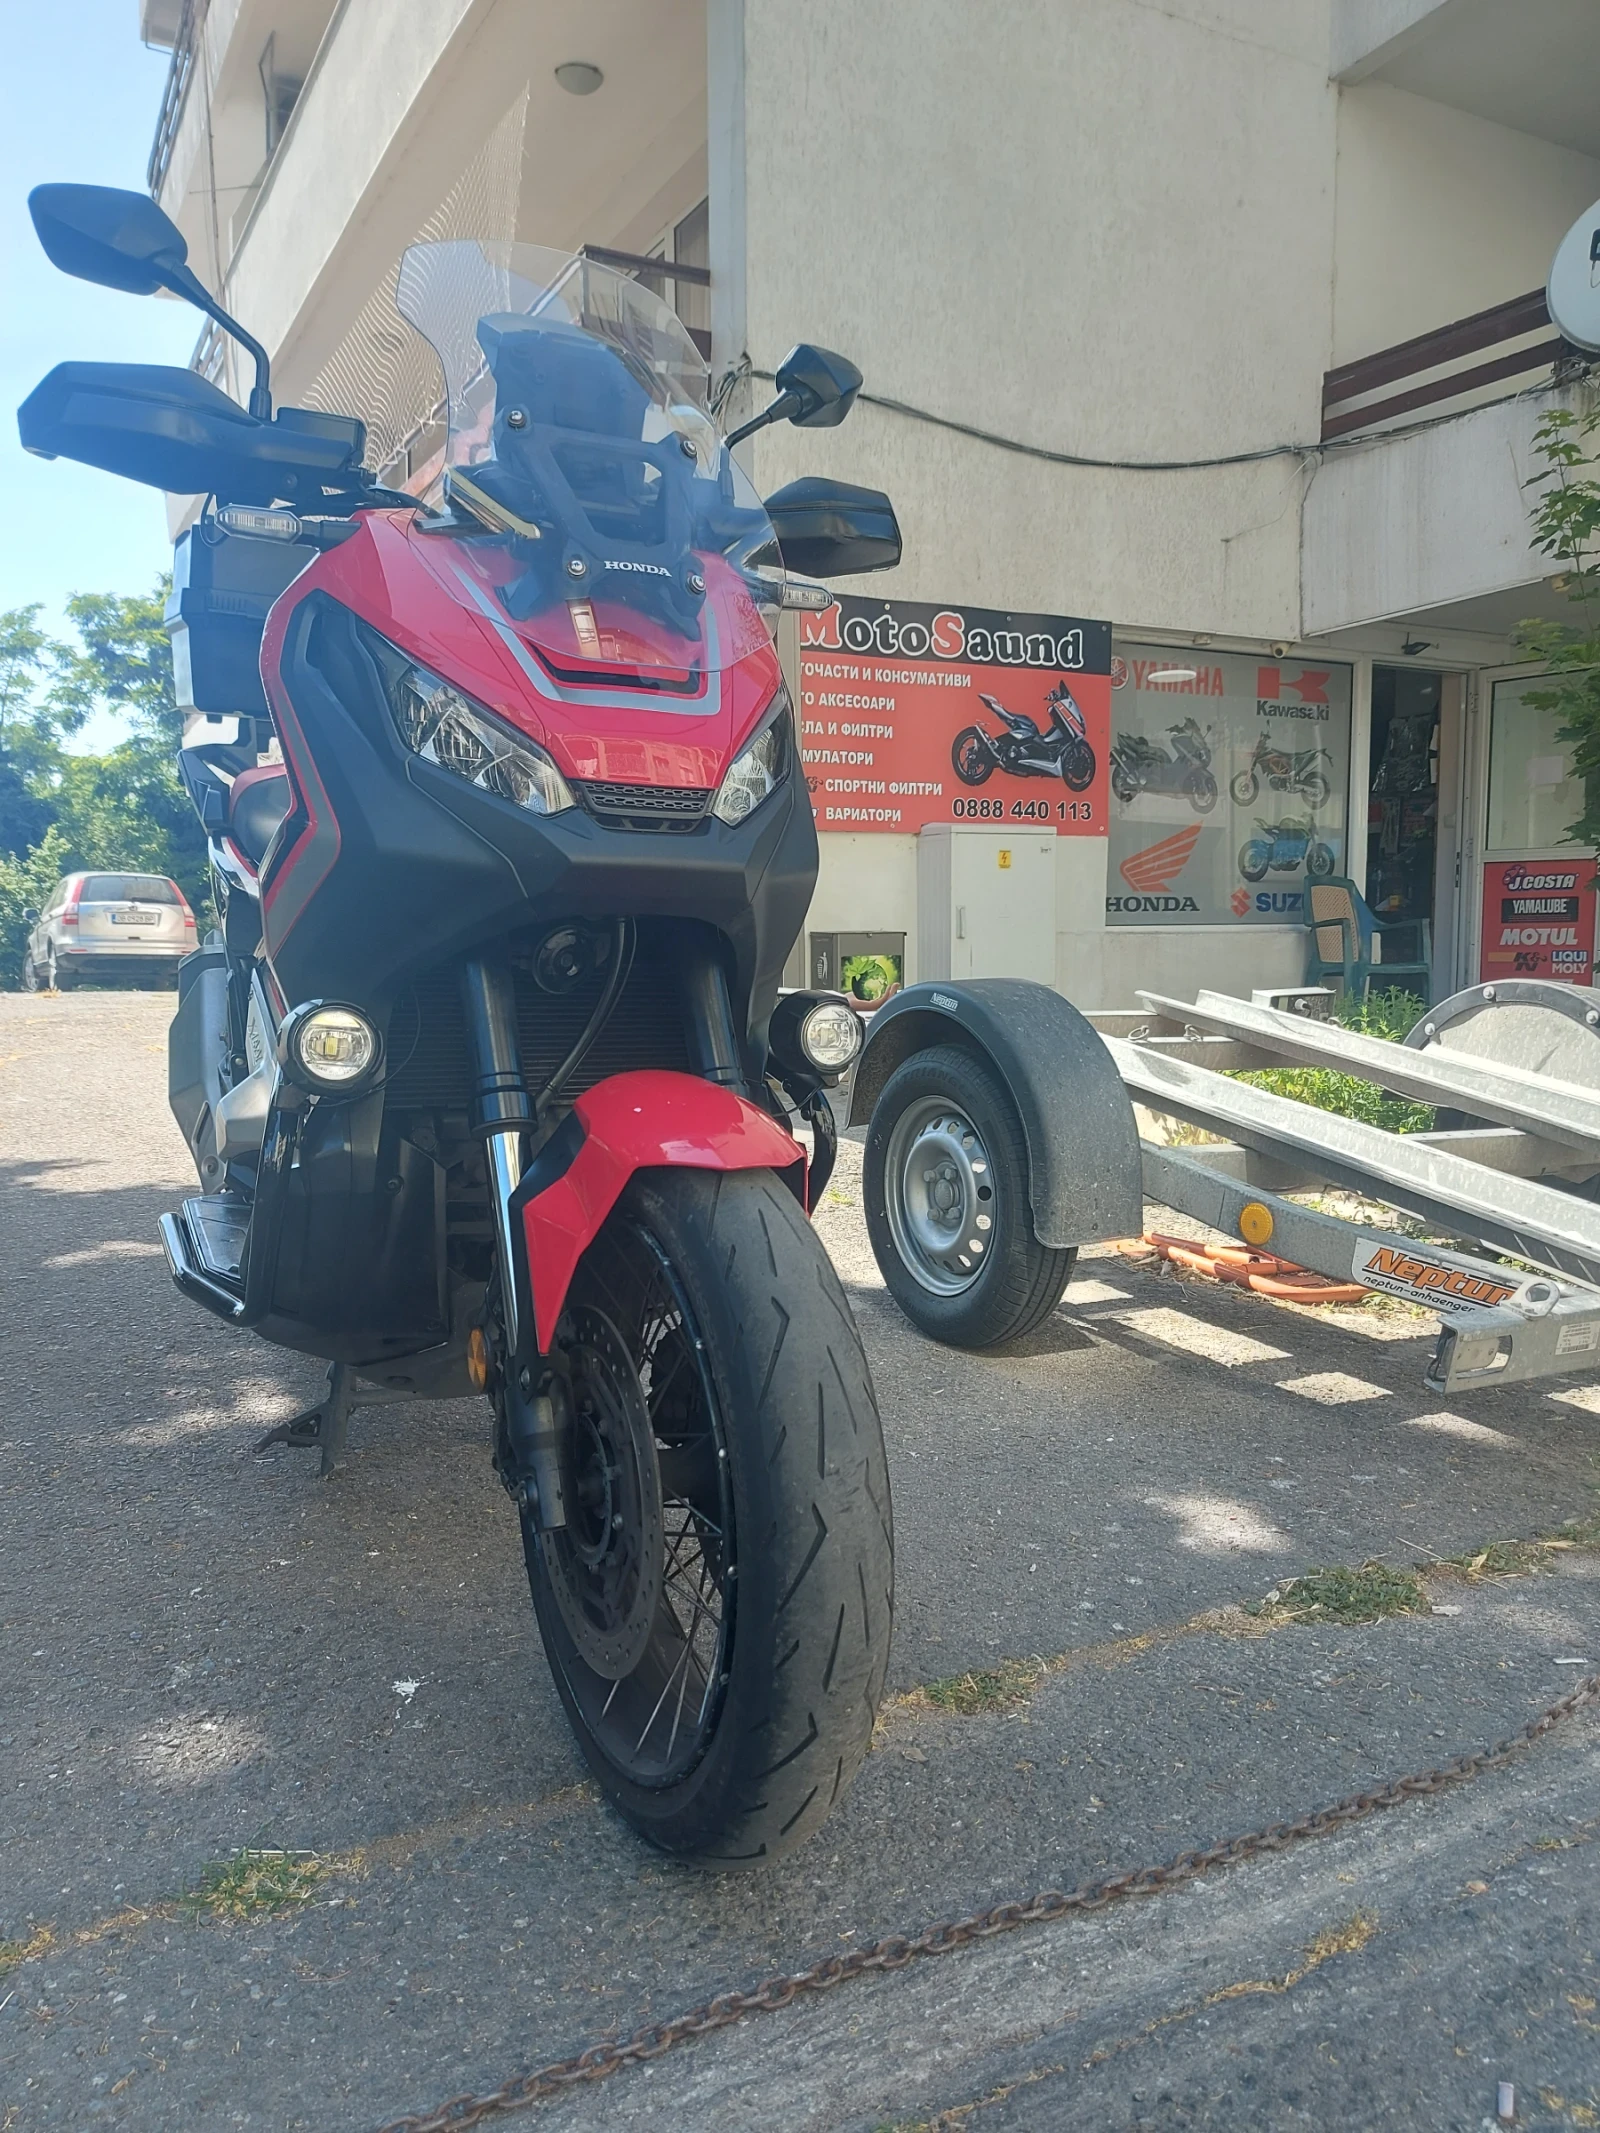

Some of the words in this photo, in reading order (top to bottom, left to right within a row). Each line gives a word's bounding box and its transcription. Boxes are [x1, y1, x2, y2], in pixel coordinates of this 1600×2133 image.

[604, 560, 673, 578] HONDA
[800, 600, 1084, 669] MotoSaund
[862, 667, 872, 681] И
[875, 668, 971, 688] КОНСУМАТИВИ
[1132, 659, 1224, 697] YAMAHA
[818, 692, 895, 711] АКСЕСОАРИ
[1256, 700, 1330, 721] Kawasaki
[827, 722, 838, 735] И
[841, 723, 893, 739] ФИЛТРИ
[825, 778, 886, 794] СПОРТНИ
[888, 781, 943, 796] ФИЛТРИ
[825, 807, 902, 822] ВАРИАТОРИ
[952, 797, 1004, 819] 0888
[1010, 799, 1051, 820] 440
[1056, 801, 1092, 821] 113
[1106, 896, 1200, 912] HONDA
[1255, 892, 1305, 913] SUZ
[1512, 898, 1568, 914] YAMALUBE
[1500, 927, 1578, 946] MOTUL
[1552, 951, 1587, 962] LIQUI
[1552, 963, 1587, 974] MOLY
[930, 992, 959, 1010] Neptun
